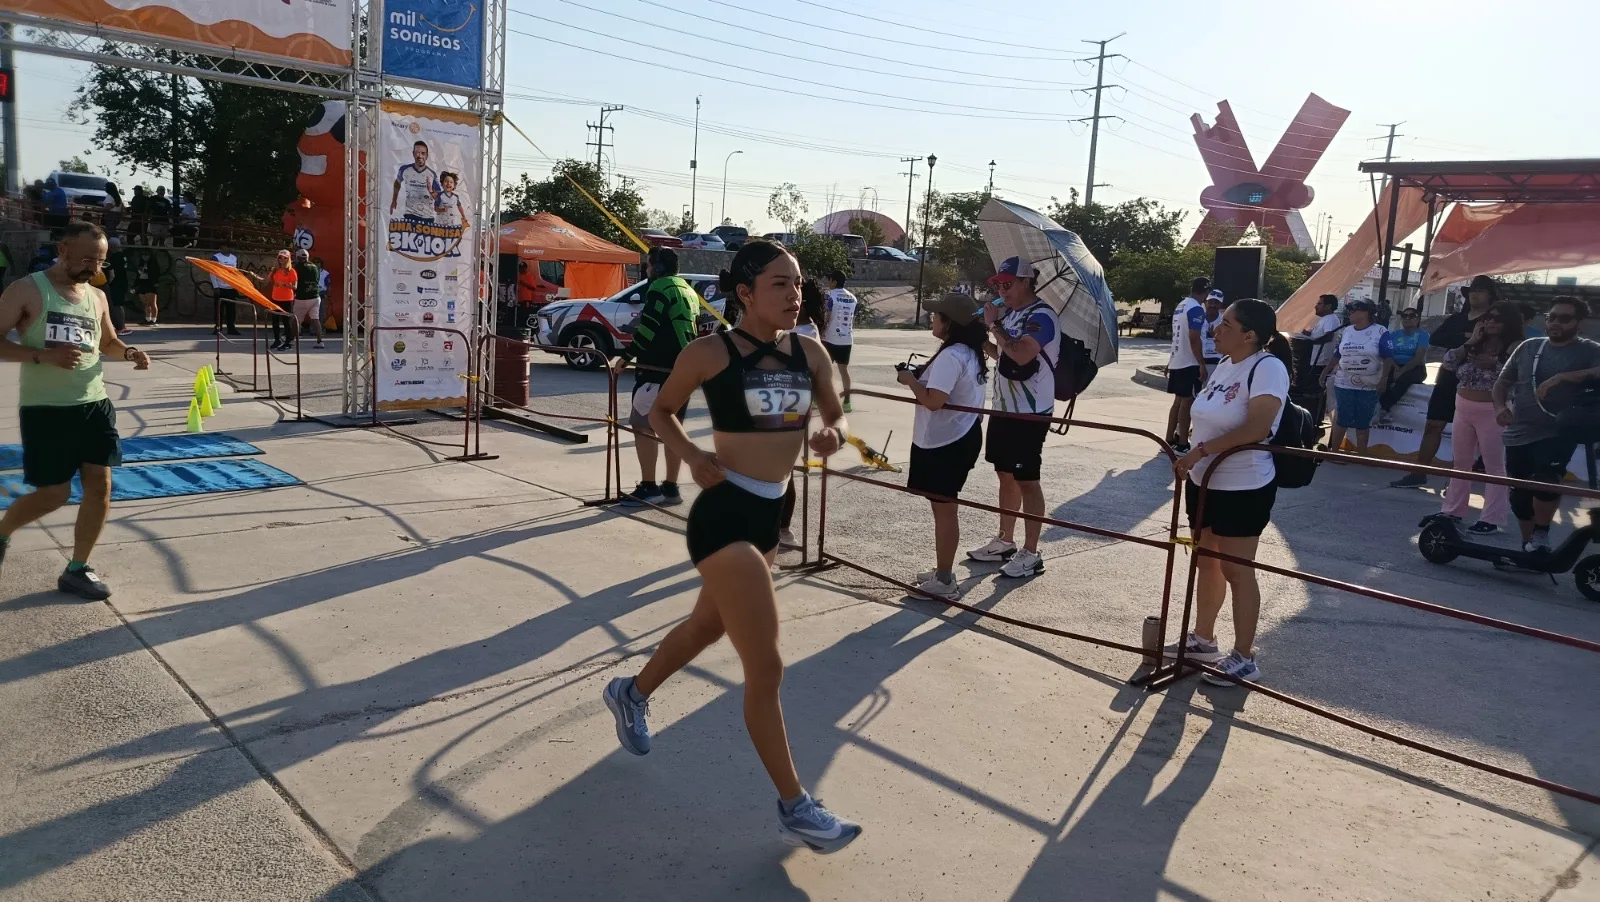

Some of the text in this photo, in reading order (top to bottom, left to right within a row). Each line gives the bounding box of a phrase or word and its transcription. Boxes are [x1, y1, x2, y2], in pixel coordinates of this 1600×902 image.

[390, 10, 416, 27] mil
[390, 28, 461, 51] sonrisas
[404, 46, 447, 57] PROGRAMA
[389, 222, 461, 237] UNA SONRISA
[389, 232, 418, 250] 3K
[424, 236, 461, 256] 10K
[758, 390, 801, 413] 372
